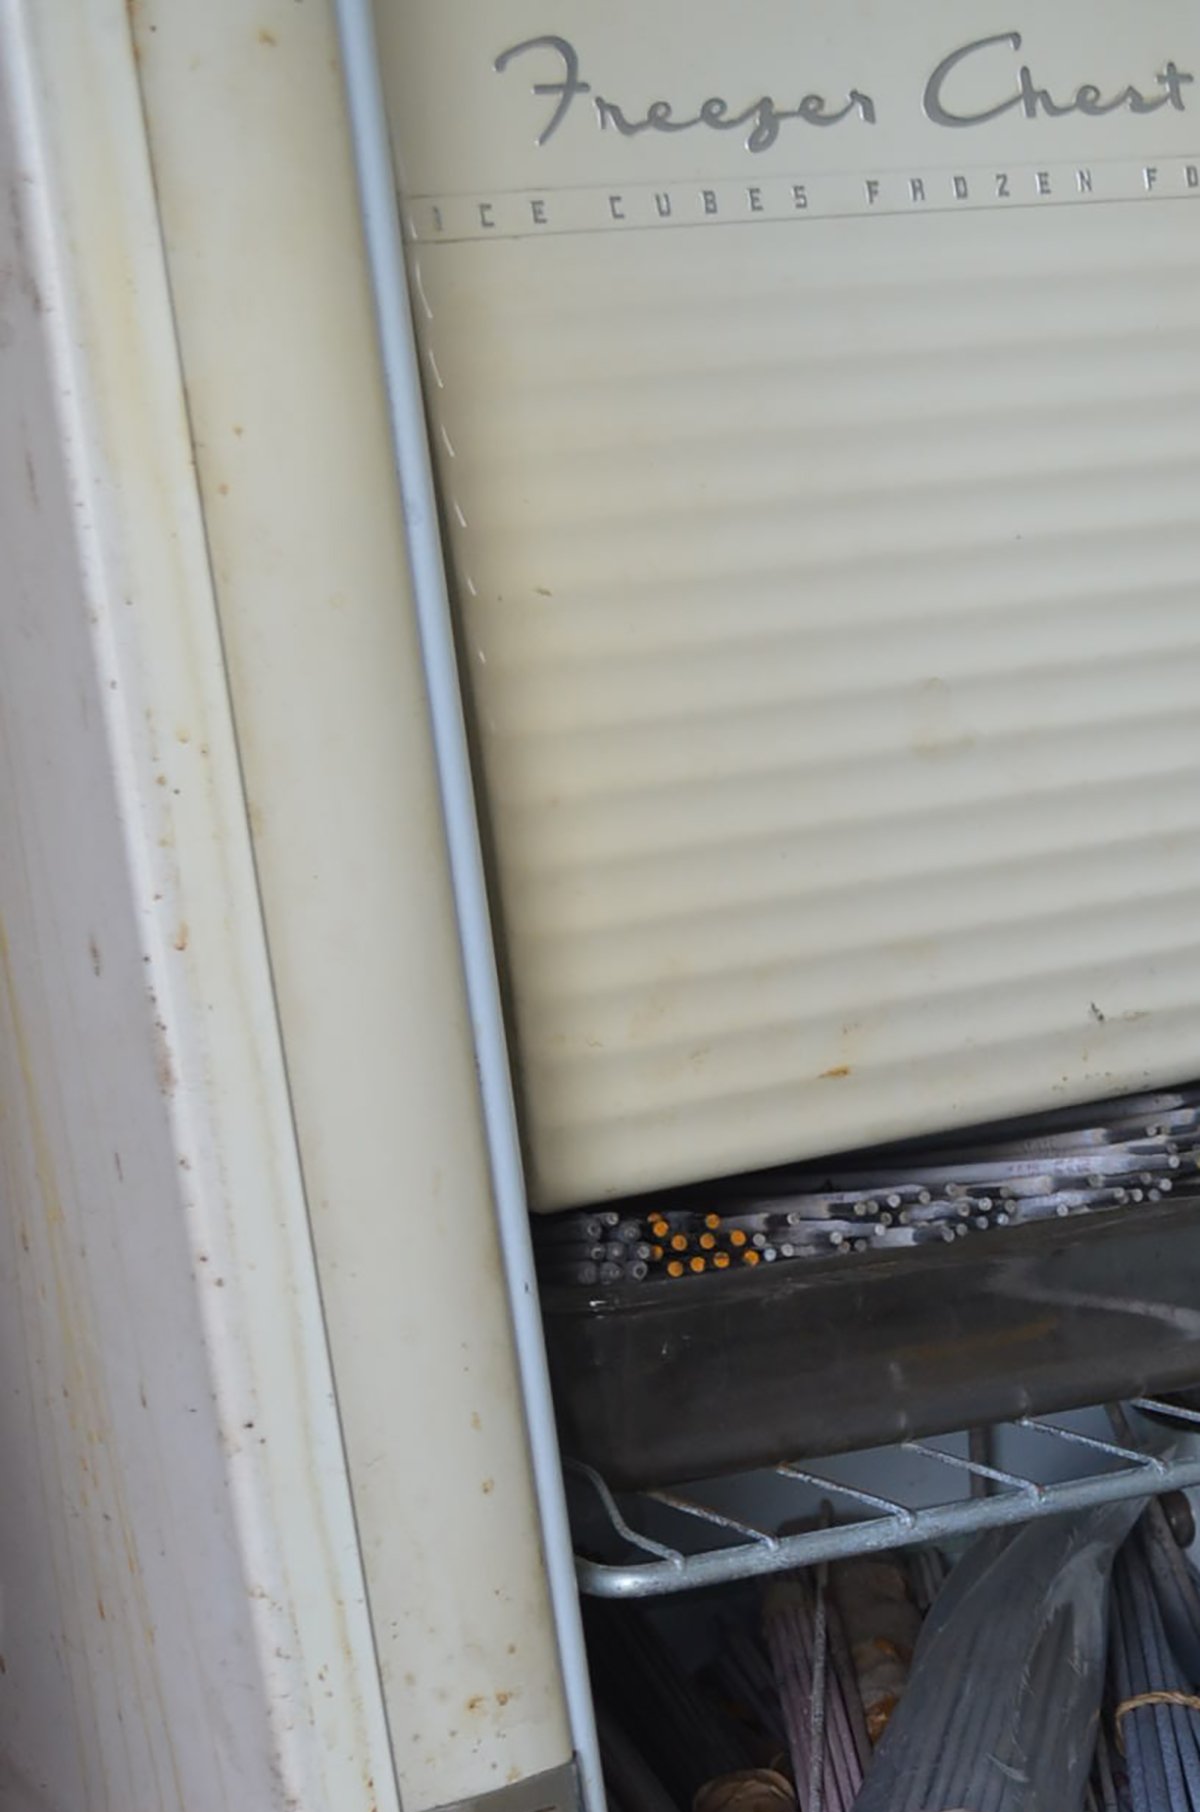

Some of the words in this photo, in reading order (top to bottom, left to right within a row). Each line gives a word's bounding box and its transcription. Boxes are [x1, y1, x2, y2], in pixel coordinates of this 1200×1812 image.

[493, 33, 876, 153] Freezer
[922, 31, 1195, 128] Chest
[608, 184, 808, 220] CUBES
[866, 169, 1095, 205] FROZEN
